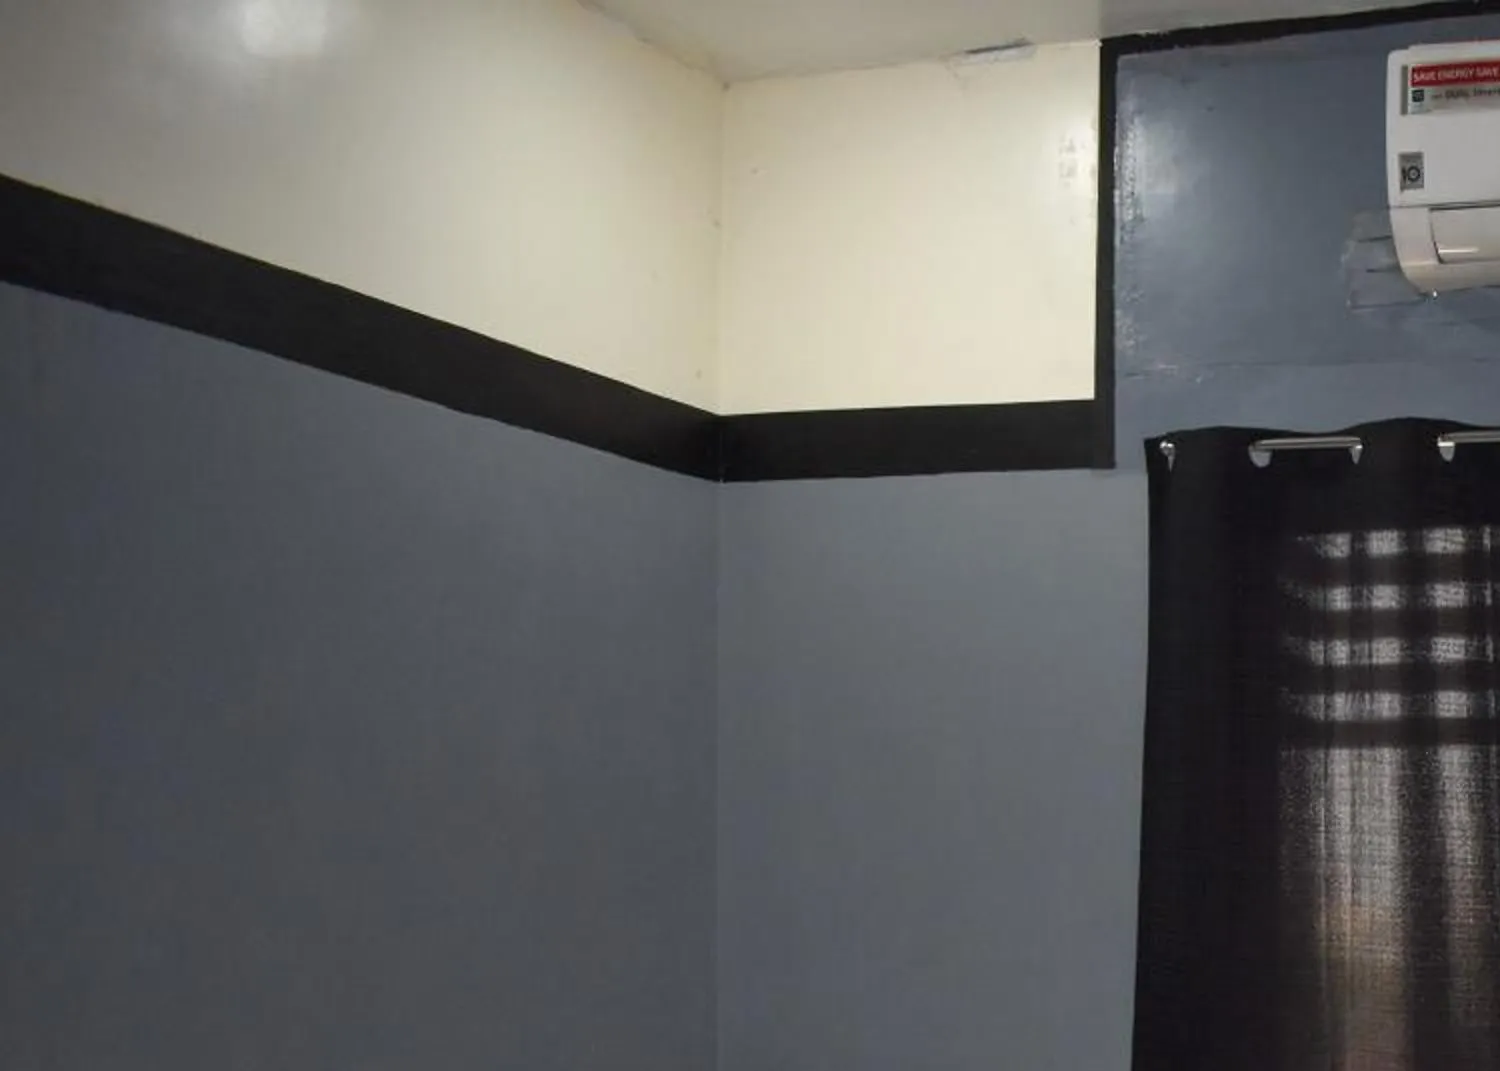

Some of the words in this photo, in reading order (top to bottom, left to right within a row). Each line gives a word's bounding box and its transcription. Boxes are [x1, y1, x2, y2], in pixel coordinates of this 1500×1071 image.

[1413, 70, 1437, 82] SAVE
[1437, 67, 1474, 80] ENERGY
[1475, 66, 1499, 78] SAVE
